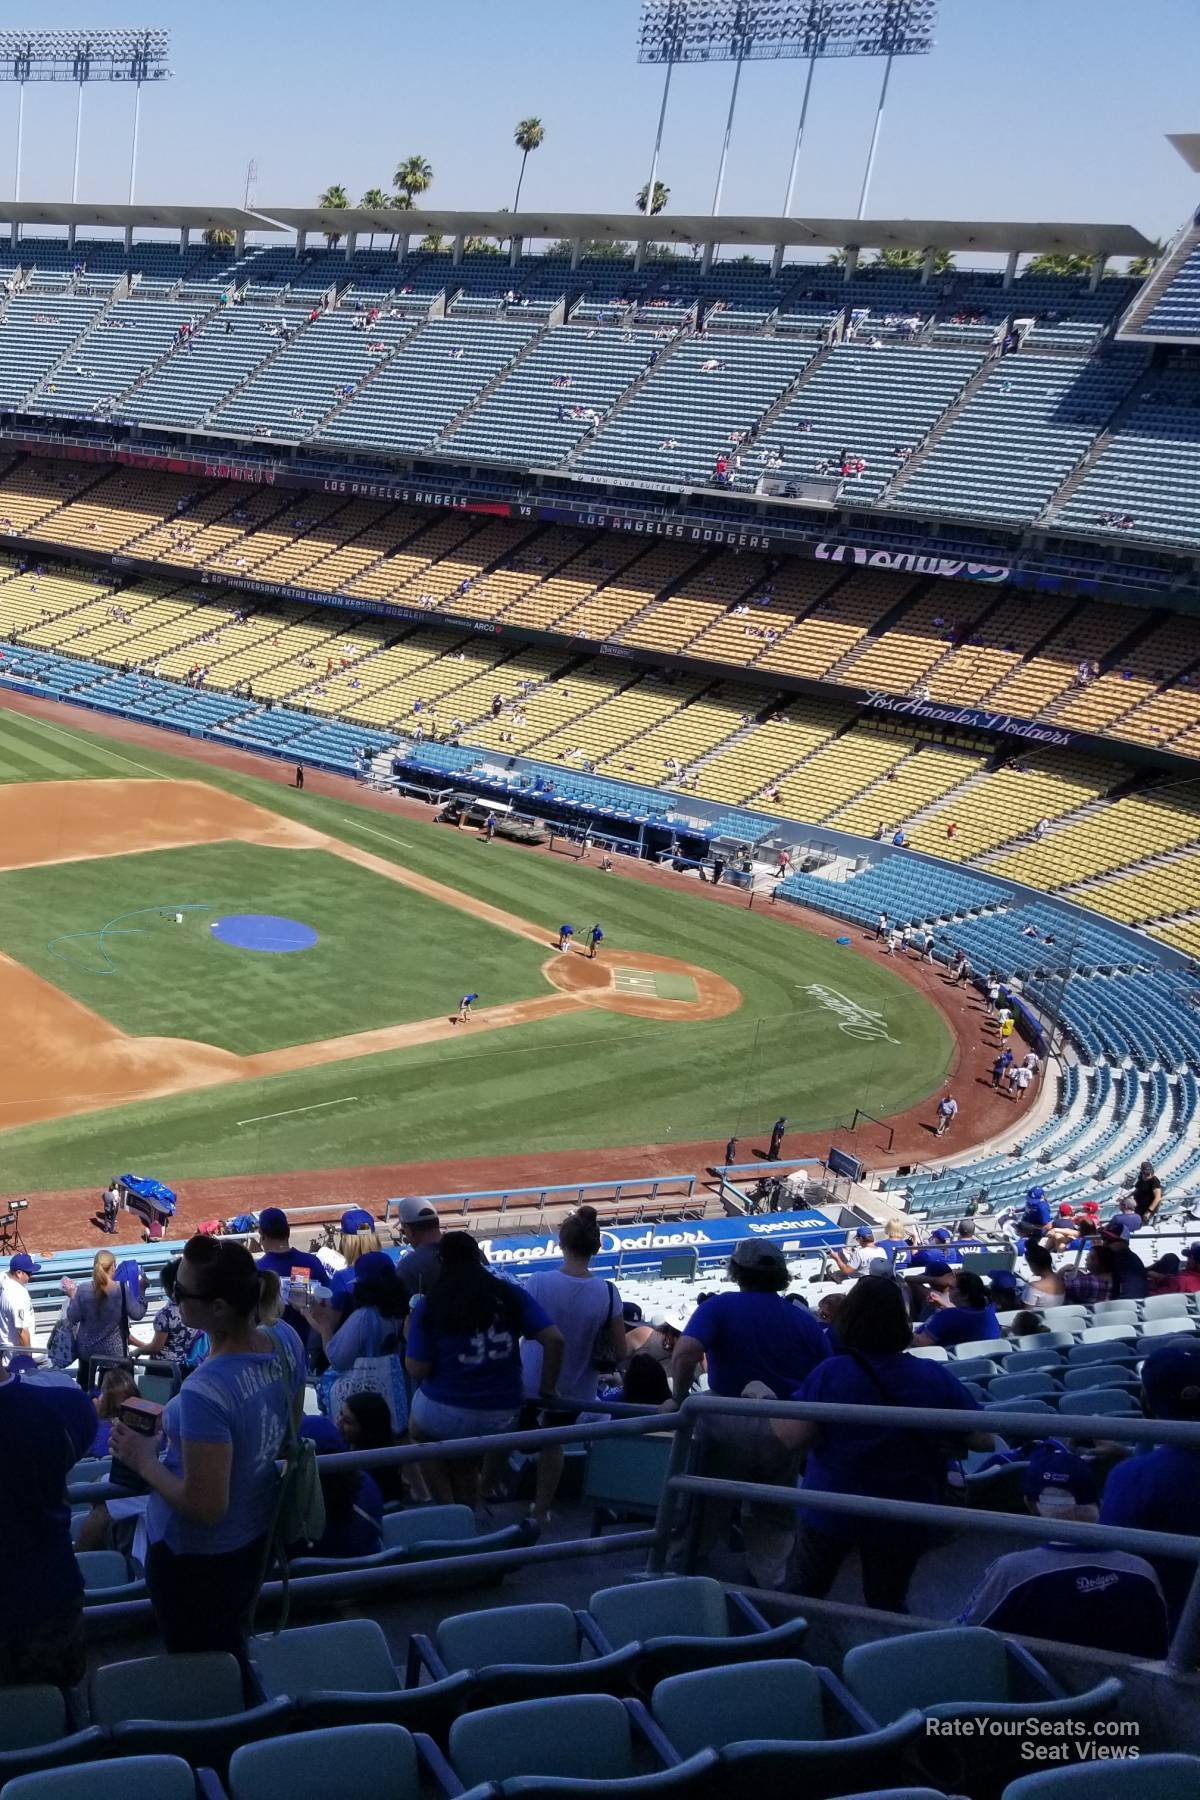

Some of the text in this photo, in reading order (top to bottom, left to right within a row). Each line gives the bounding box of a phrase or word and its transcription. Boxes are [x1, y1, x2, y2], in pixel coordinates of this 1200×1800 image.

[613, 479, 635, 487] CLUB
[324, 480, 770, 549] LOS ANGELES ANGELS VS LOS ANGELES DODGERS
[228, 579, 280, 593] ANNIVERSARY
[281, 588, 306, 599] RETRO
[307, 592, 343, 605] CLAYTON
[345, 599, 385, 612] KERSHAW
[474, 622, 495, 632] ARCO
[856, 689, 1073, 746] Los Angeles Dodgers
[749, 1218, 826, 1234] Spectrum
[600, 1230, 712, 1252] Dodgers
[1076, 1572, 1120, 1592] Dodgers
